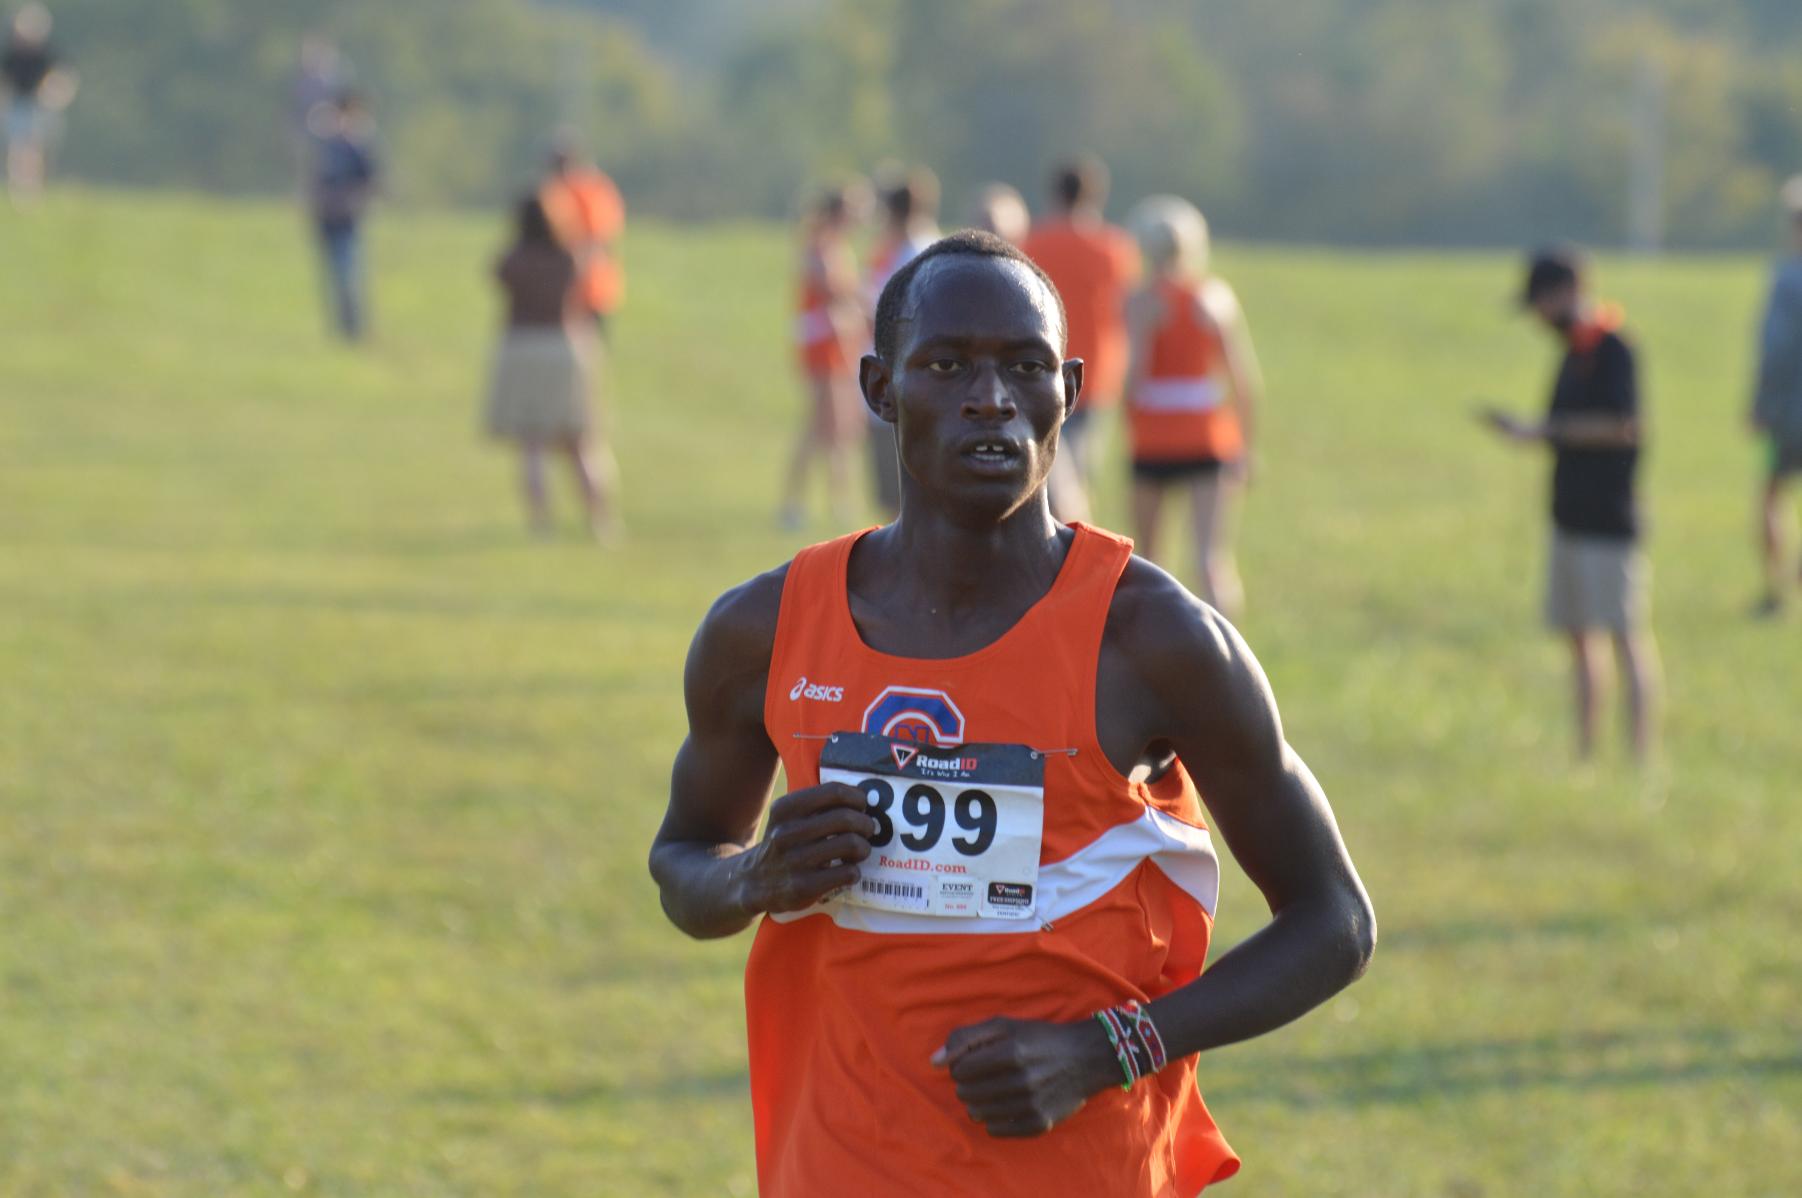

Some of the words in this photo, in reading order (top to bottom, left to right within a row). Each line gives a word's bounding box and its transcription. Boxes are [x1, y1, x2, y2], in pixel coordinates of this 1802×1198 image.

[803, 682, 845, 702] asics
[915, 754, 977, 771] RoadID
[857, 777, 997, 857] 899
[879, 855, 967, 874] RoadID.com
[942, 883, 974, 893] EVENT
